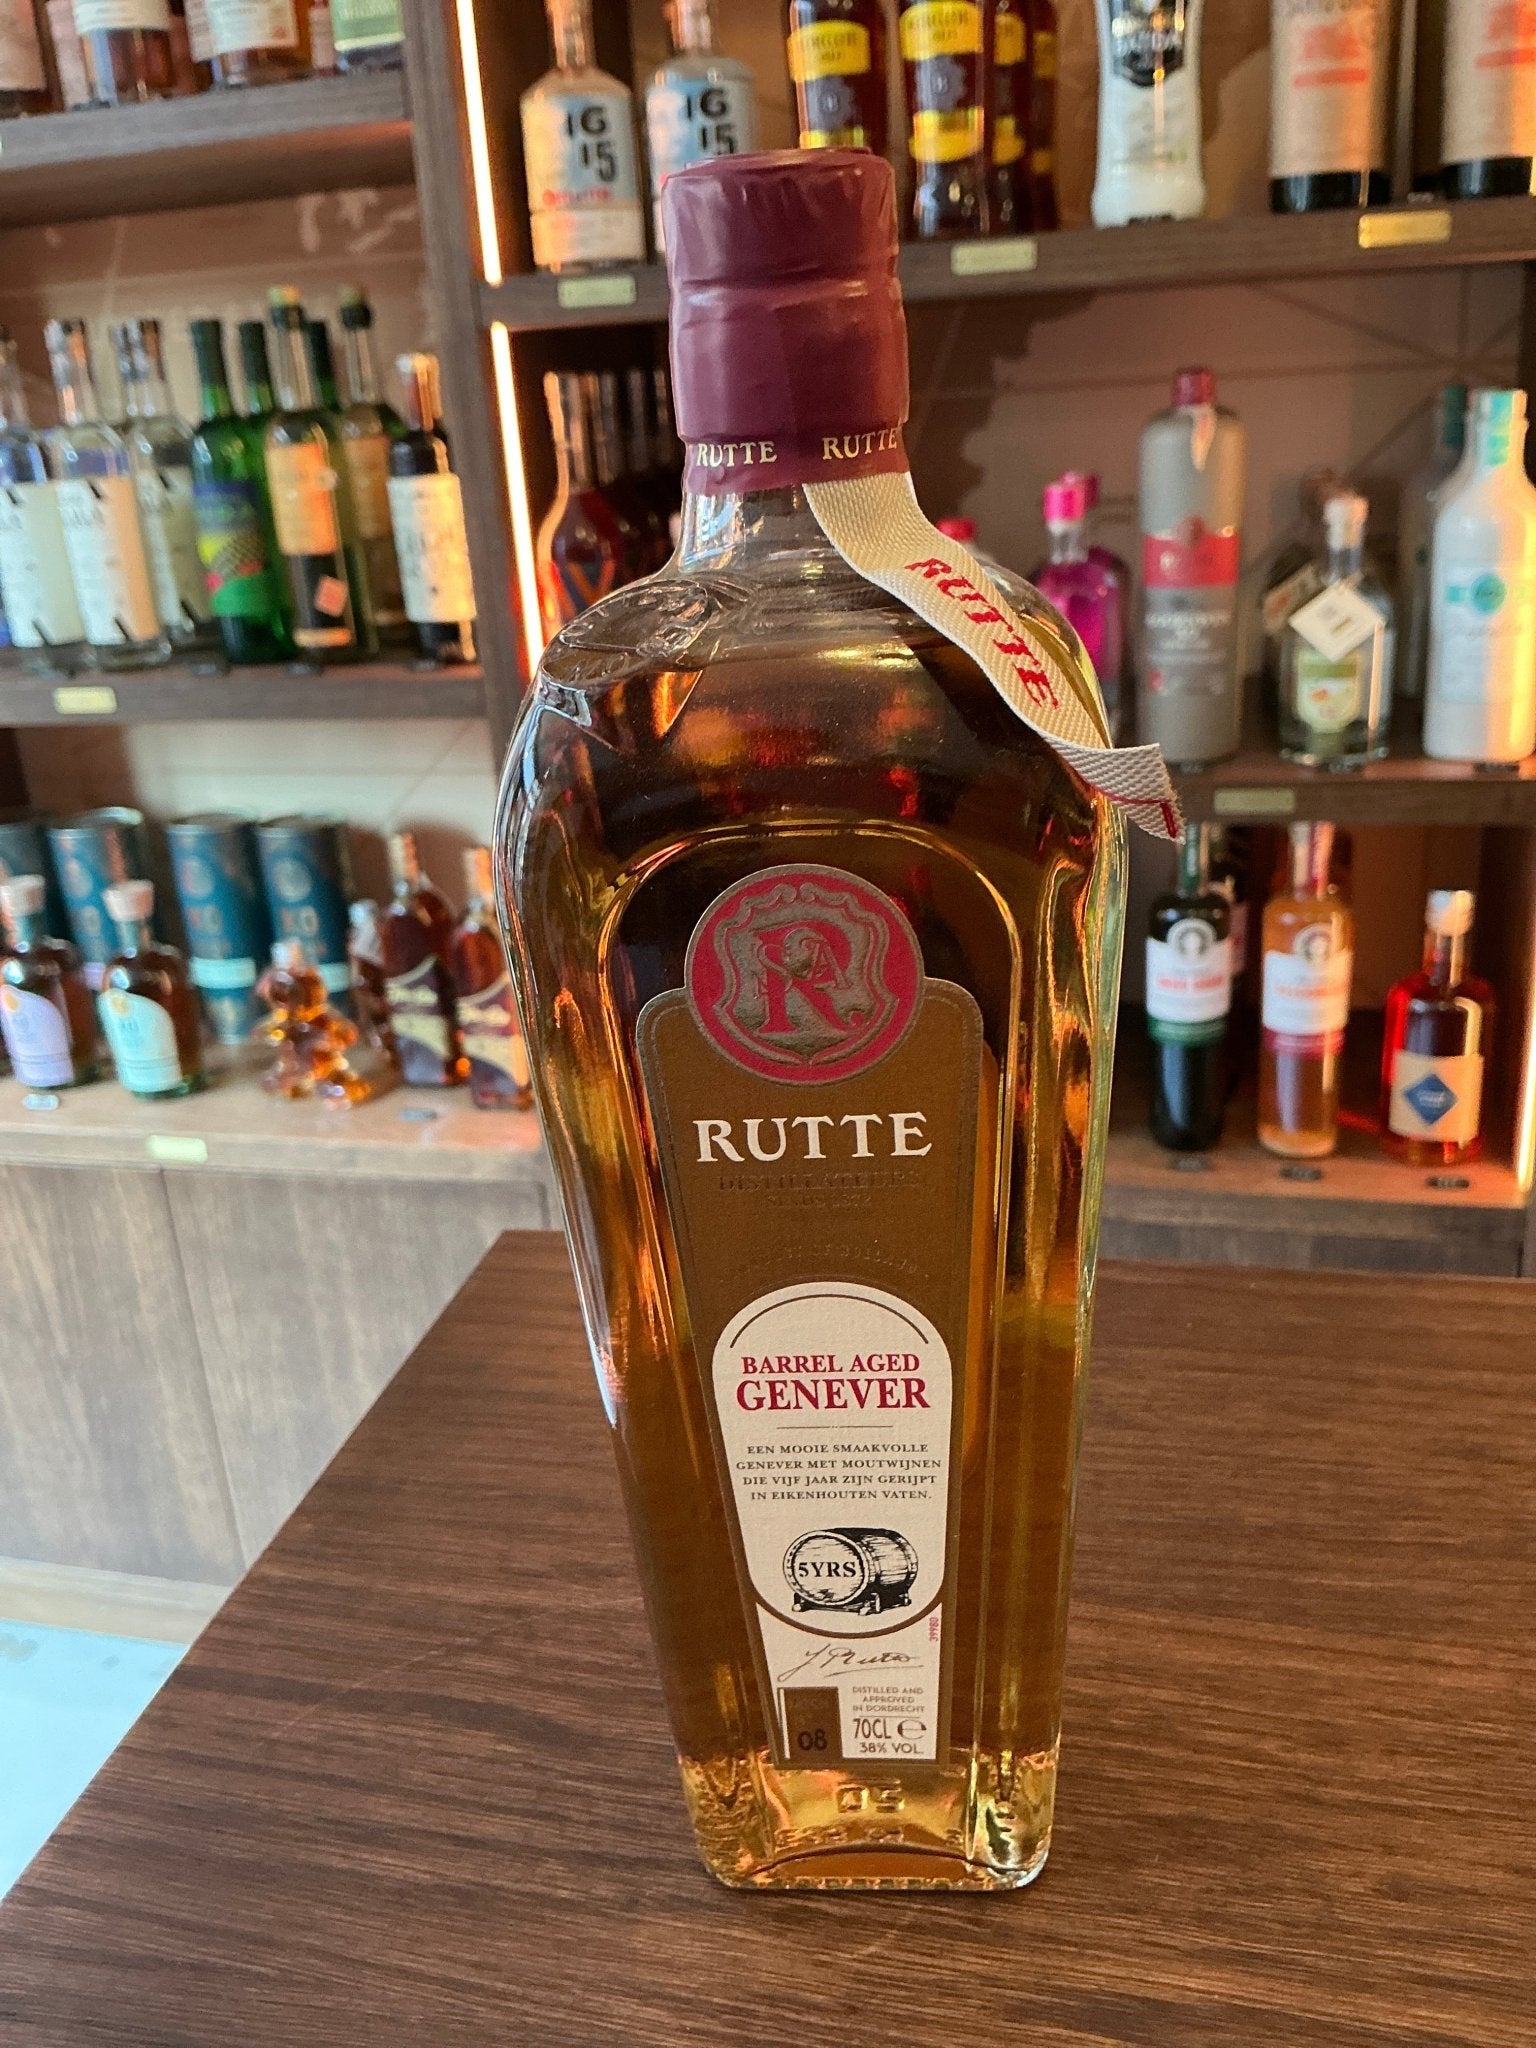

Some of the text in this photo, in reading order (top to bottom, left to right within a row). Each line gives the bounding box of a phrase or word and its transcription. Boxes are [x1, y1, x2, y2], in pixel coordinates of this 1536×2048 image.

[822, 427, 897, 460] RUTTE
[696, 440, 778, 468] RUTTE
[904, 557, 1059, 709] RUTTE
[692, 1111, 932, 1162] RUTTE
[741, 1354, 920, 1374] BARREL AGED
[736, 1378, 931, 1411] GENEVER
[747, 1444, 929, 1454] EEN MOOIE SMAAKVOLLE
[736, 1459, 942, 1470] GENEVER MET MOUTWIJNEN
[743, 1474, 937, 1486] DIE VIJF JAAR ZIJN GERIJPT
[750, 1490, 932, 1500] IN EIKENHOUTEN VATEN.
[798, 1561, 857, 1578] 5YRS
[852, 1686, 924, 1694] DISTILLED AND
[866, 1705, 925, 1713] DORDRECHT
[852, 1718, 892, 1739] 70CL
[860, 1743, 887, 1753] 38%
